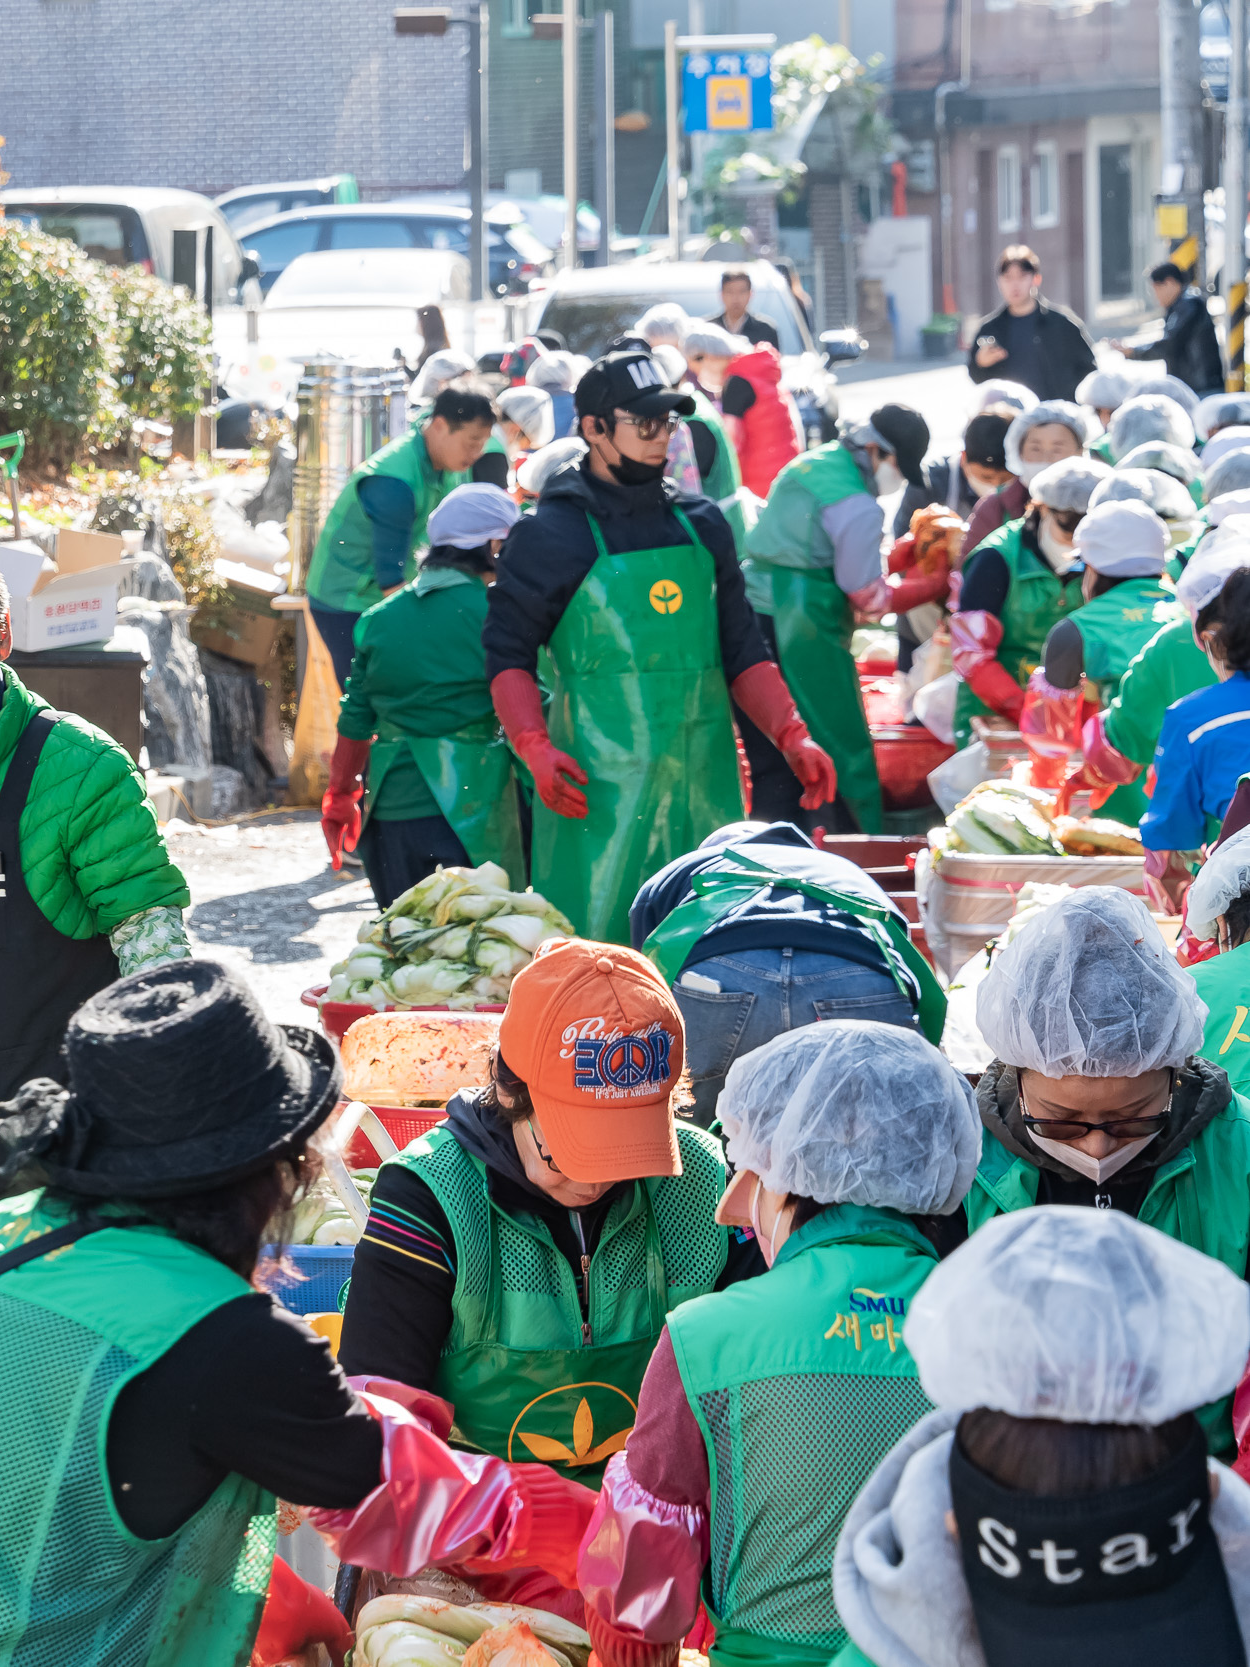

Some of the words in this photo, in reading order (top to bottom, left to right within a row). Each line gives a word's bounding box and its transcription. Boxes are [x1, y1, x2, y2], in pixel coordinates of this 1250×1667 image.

[611, 1089, 628, 1099] JUST
[630, 1085, 661, 1098] AWESOME
[849, 1290, 905, 1316] SMU
[978, 1498, 1201, 1585] Star
